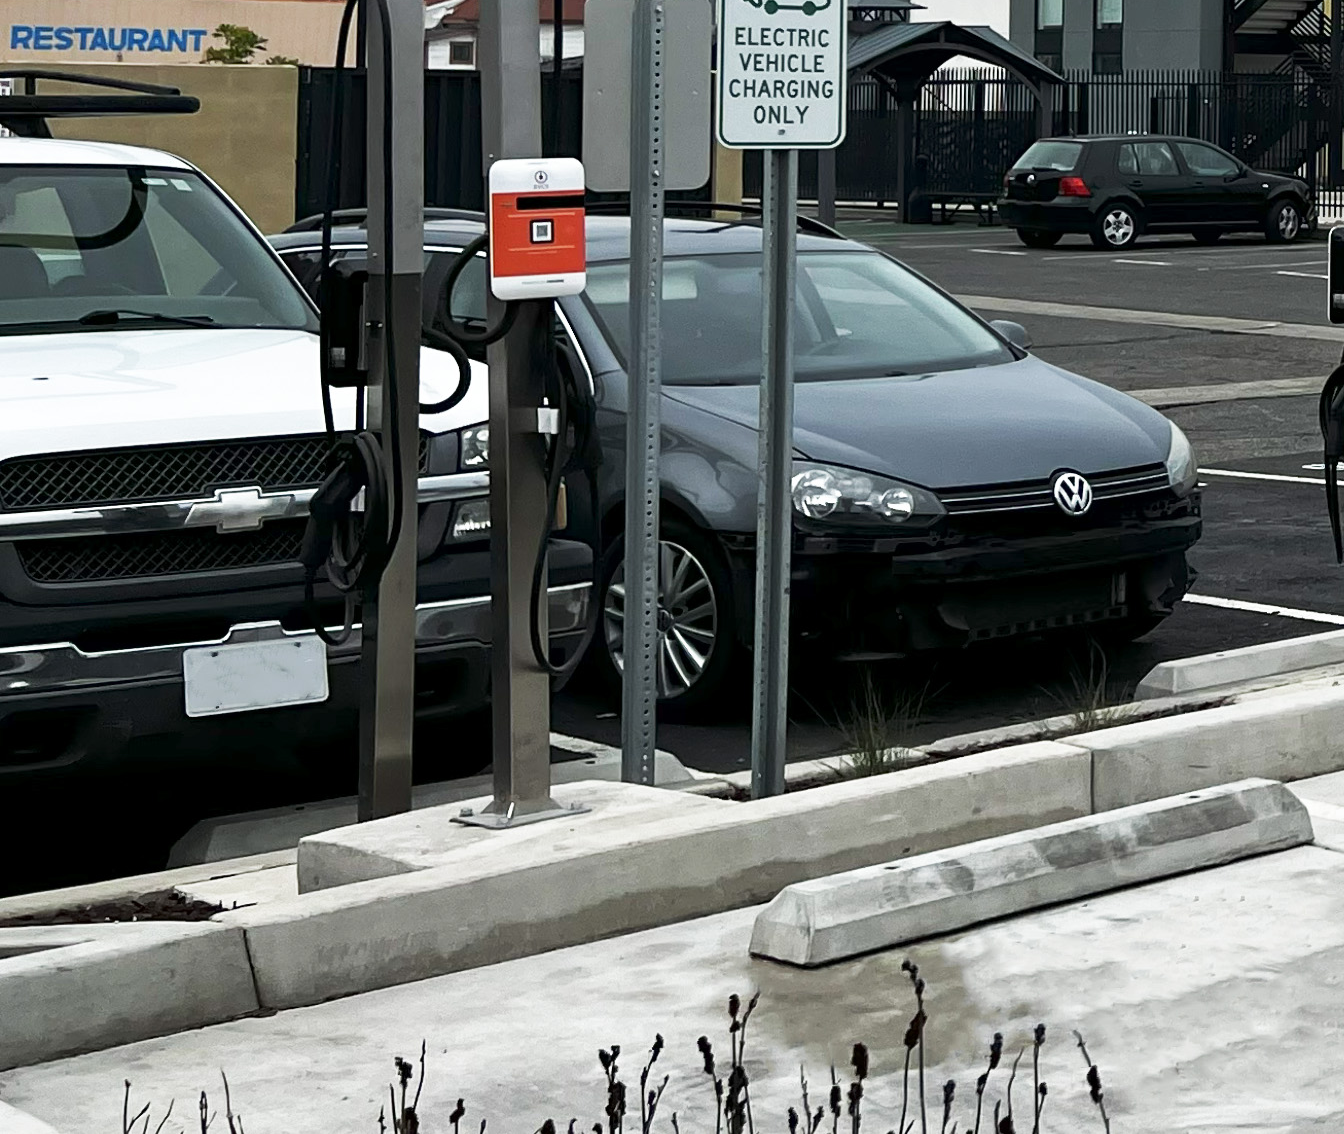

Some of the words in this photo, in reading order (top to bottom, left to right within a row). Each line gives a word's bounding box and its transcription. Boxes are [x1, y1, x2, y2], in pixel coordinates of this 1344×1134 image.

[10, 24, 208, 53] RESTAURANT
[734, 26, 830, 48] ELECTRIC
[739, 52, 825, 73] VEHICLE
[728, 78, 834, 99] CHARGING
[753, 104, 810, 125] ONLY
[1053, 471, 1093, 516] VW
